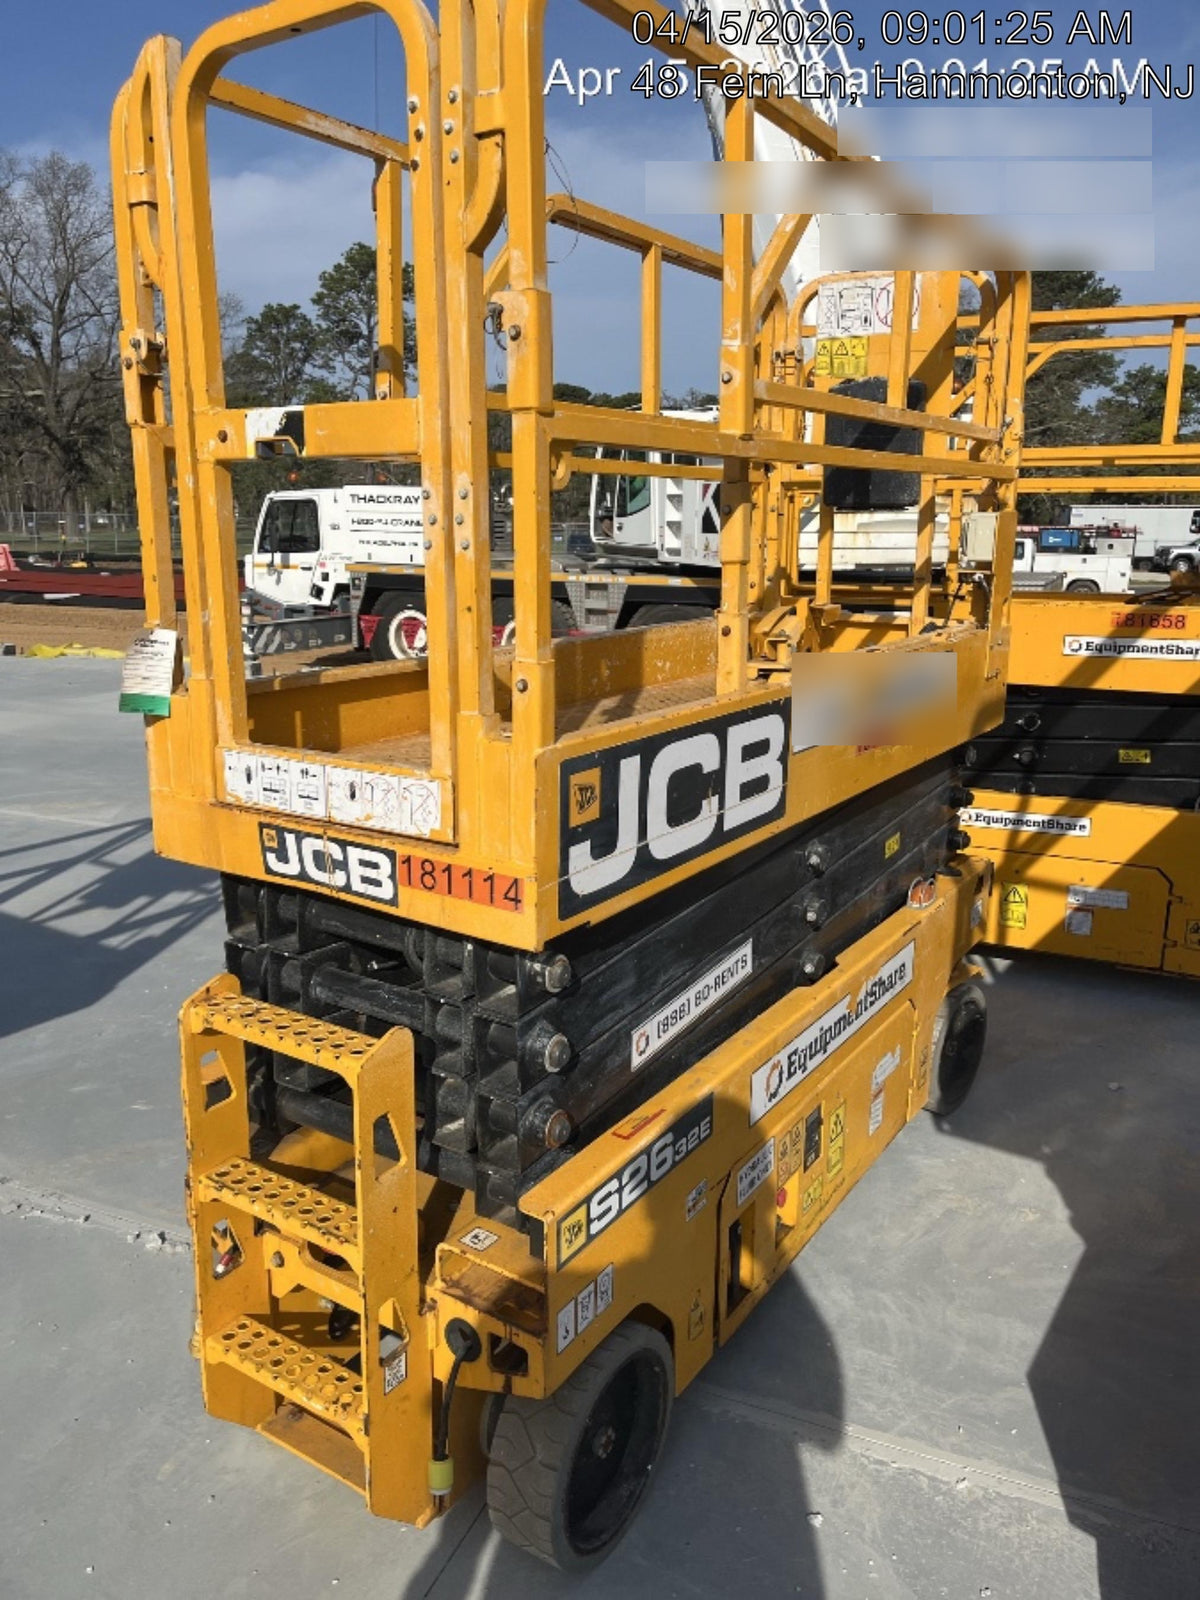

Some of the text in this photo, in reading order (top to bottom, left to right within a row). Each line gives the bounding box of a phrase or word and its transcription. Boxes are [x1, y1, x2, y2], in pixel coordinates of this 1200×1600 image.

[349, 493, 421, 504] THACKRAY
[568, 713, 786, 897] JCB
[974, 812, 1087, 832] EquipmentShare
[265, 831, 394, 900] JCB
[401, 855, 522, 911] 181114
[694, 953, 748, 1007] 80-RENTS
